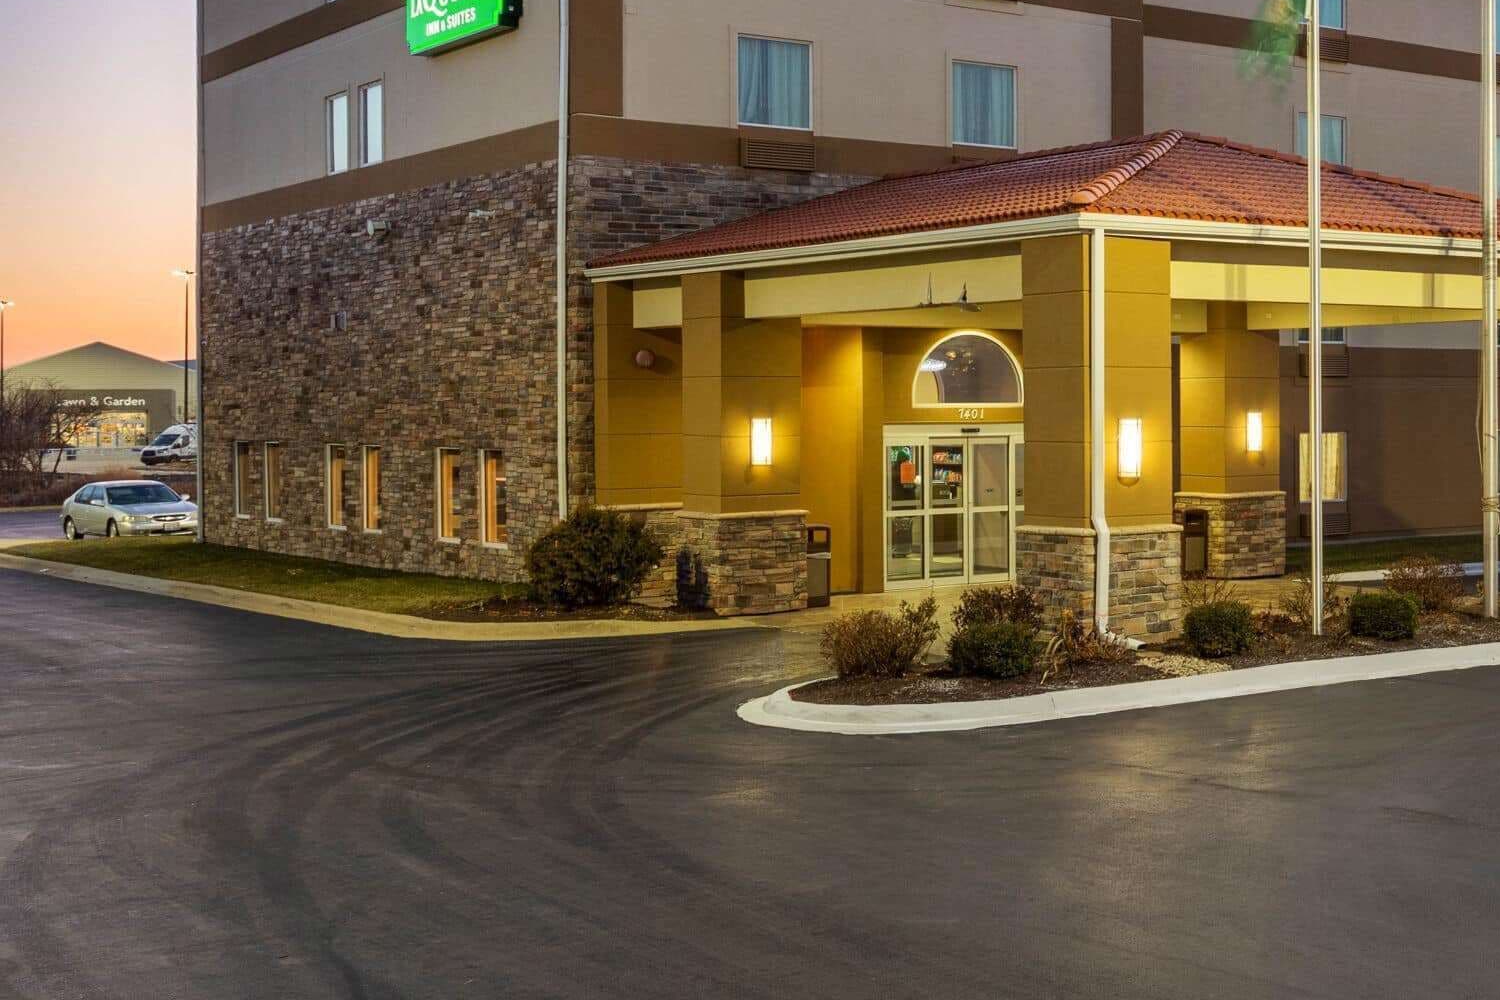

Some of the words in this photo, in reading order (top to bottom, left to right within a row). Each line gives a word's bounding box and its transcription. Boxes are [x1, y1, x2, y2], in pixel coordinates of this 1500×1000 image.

[426, 20, 440, 37] INN
[447, 7, 476, 30] SUITES
[57, 398, 86, 407] awn
[90, 396, 99, 406] &
[103, 396, 146, 407] Garden
